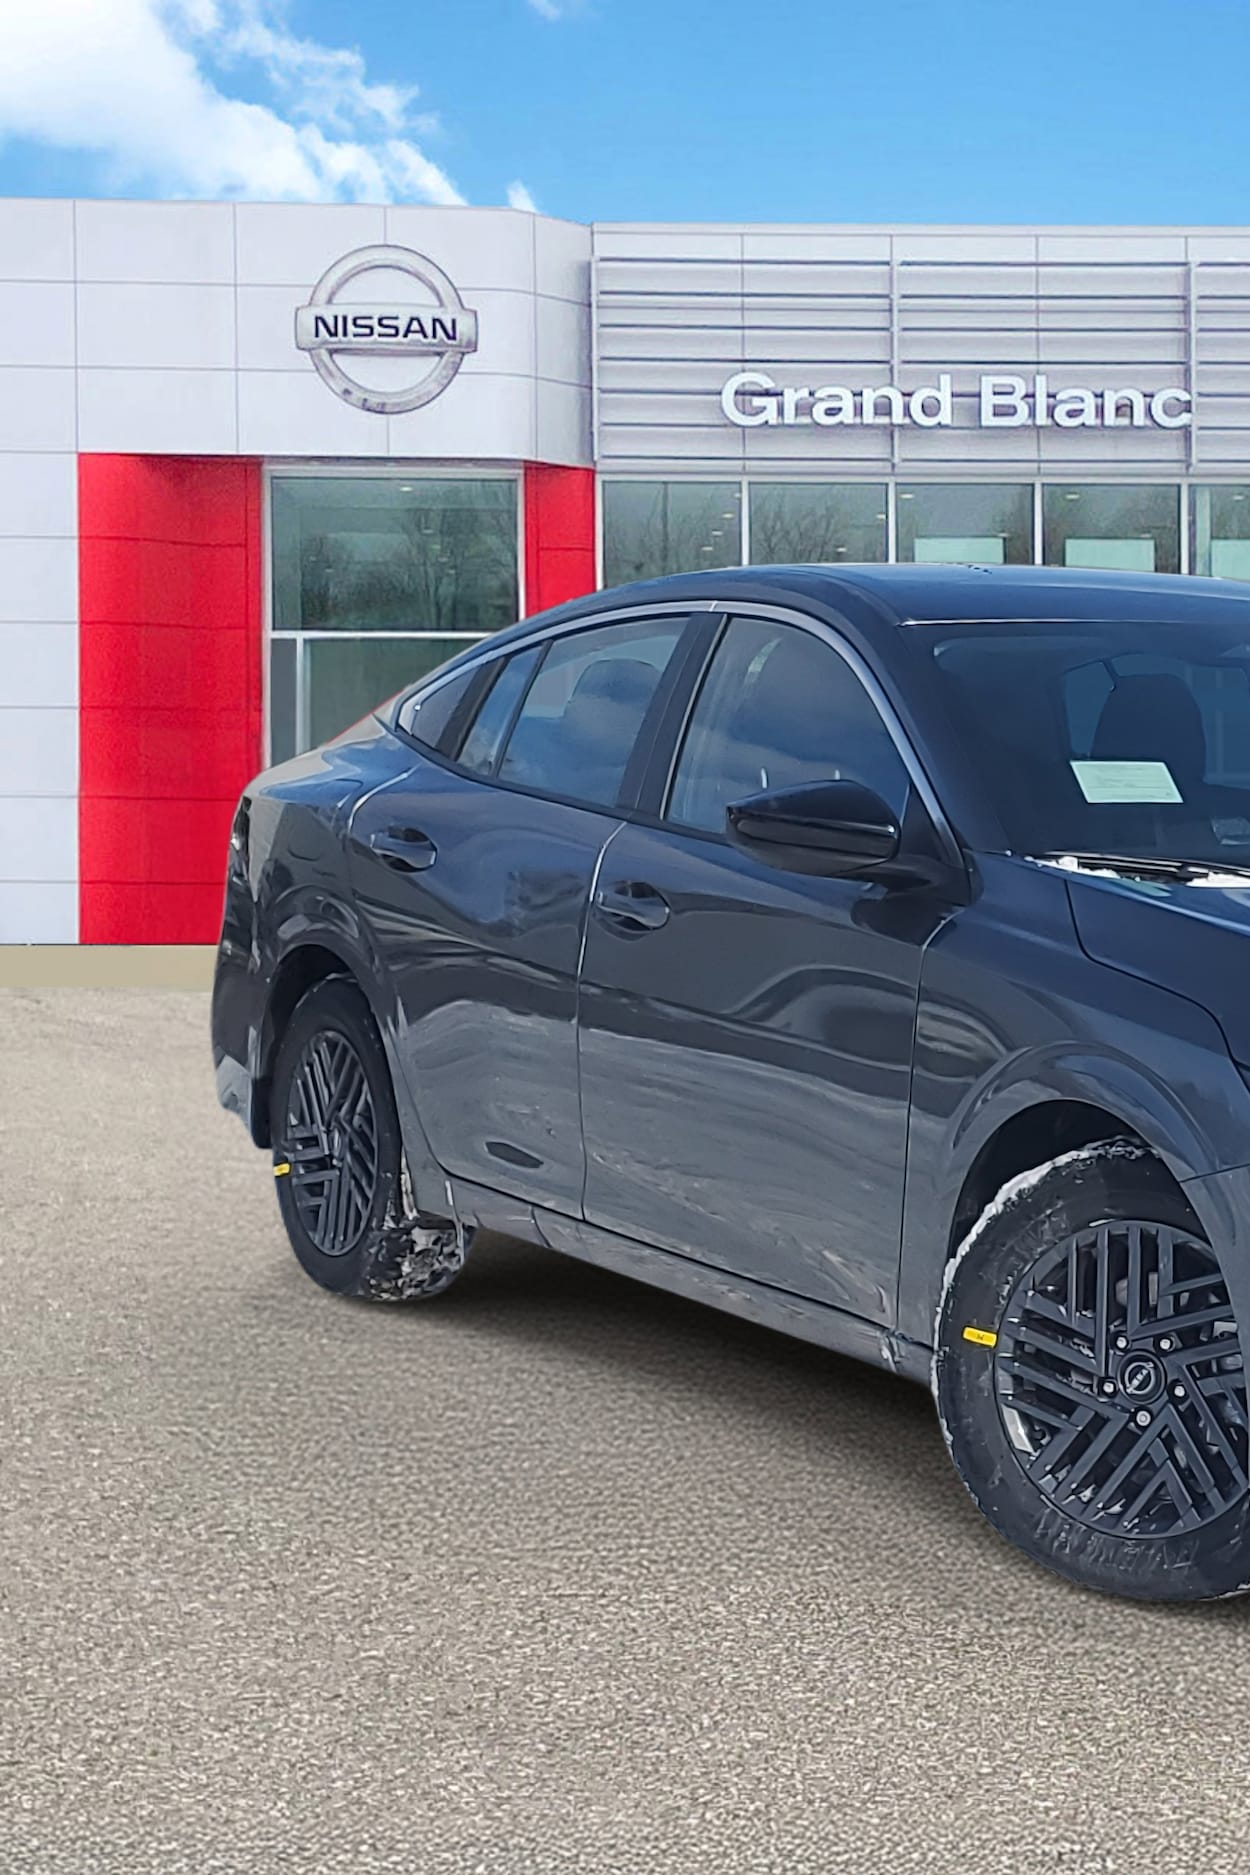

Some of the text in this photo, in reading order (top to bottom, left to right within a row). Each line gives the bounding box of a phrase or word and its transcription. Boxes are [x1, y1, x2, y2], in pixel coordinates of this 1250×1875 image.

[314, 315, 457, 341] NISSAN
[720, 371, 1194, 428] Grand Blanc
